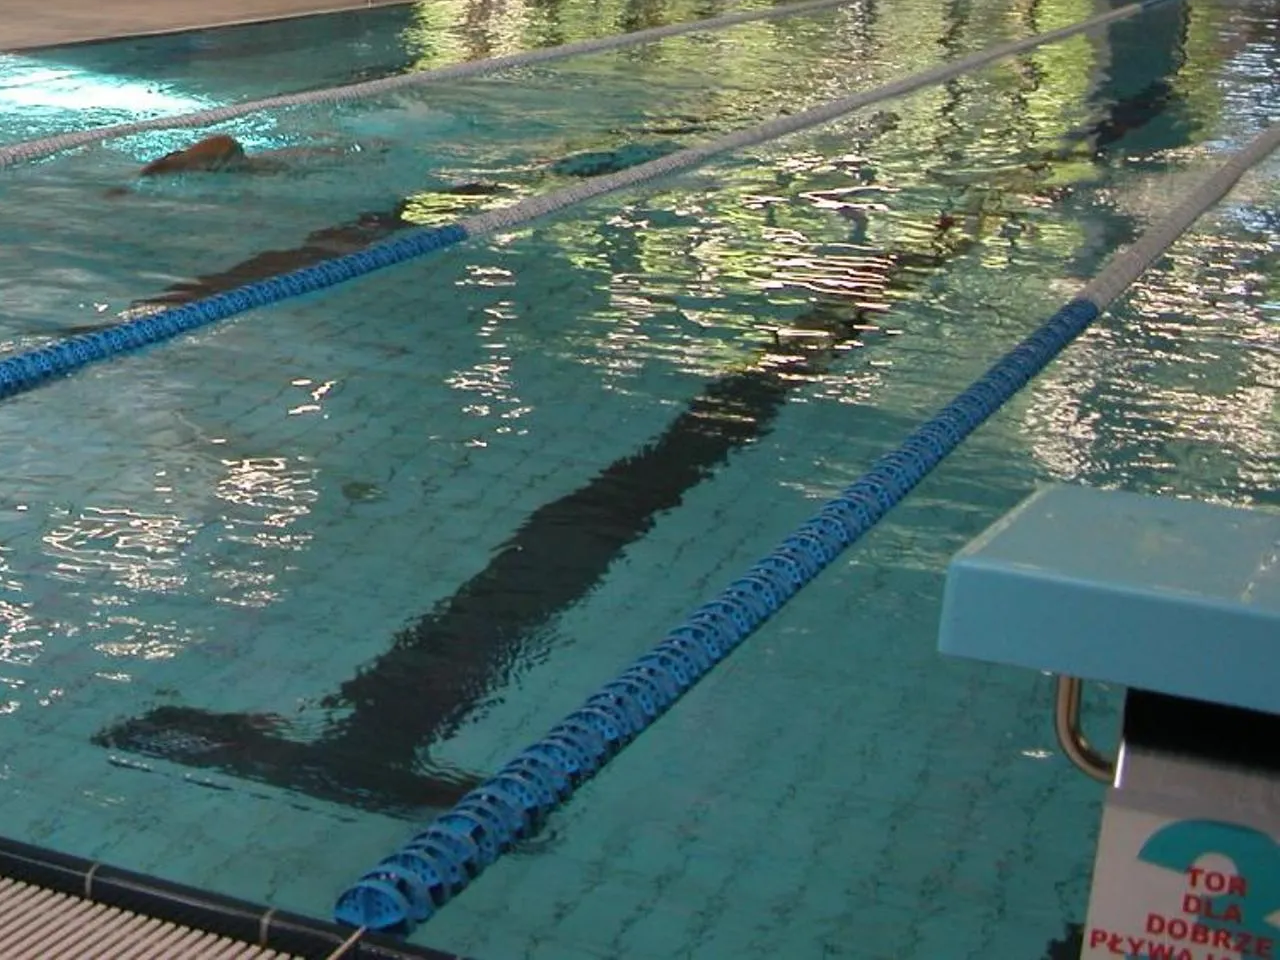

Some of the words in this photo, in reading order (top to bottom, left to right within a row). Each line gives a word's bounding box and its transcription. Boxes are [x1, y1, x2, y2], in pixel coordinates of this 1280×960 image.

[1184, 864, 1248, 897] TOR
[1182, 893, 1242, 924] DLA
[1145, 913, 1274, 958] DOBRZE
